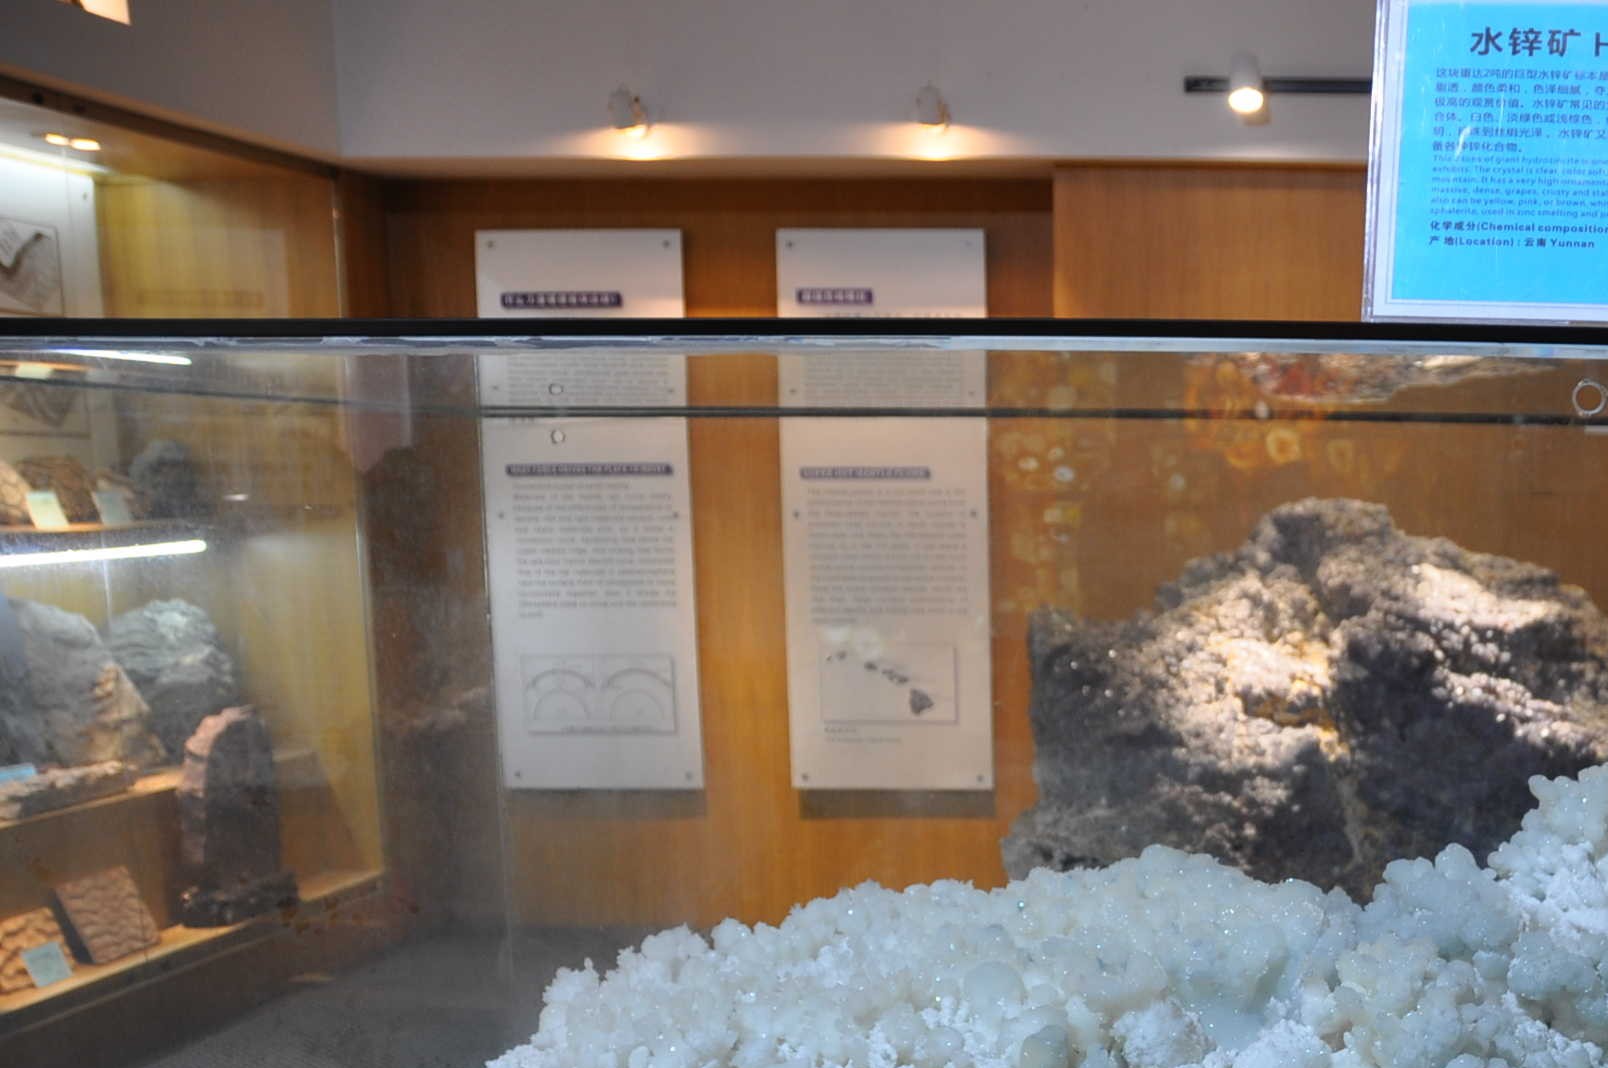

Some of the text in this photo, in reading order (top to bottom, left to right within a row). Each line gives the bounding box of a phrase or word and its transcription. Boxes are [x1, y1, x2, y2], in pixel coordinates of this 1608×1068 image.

[1470, 27, 1582, 58] 水锌矿
[1492, 167, 1524, 176] crystal
[1572, 189, 1590, 197] and
[1549, 238, 1595, 249] Yunnan
